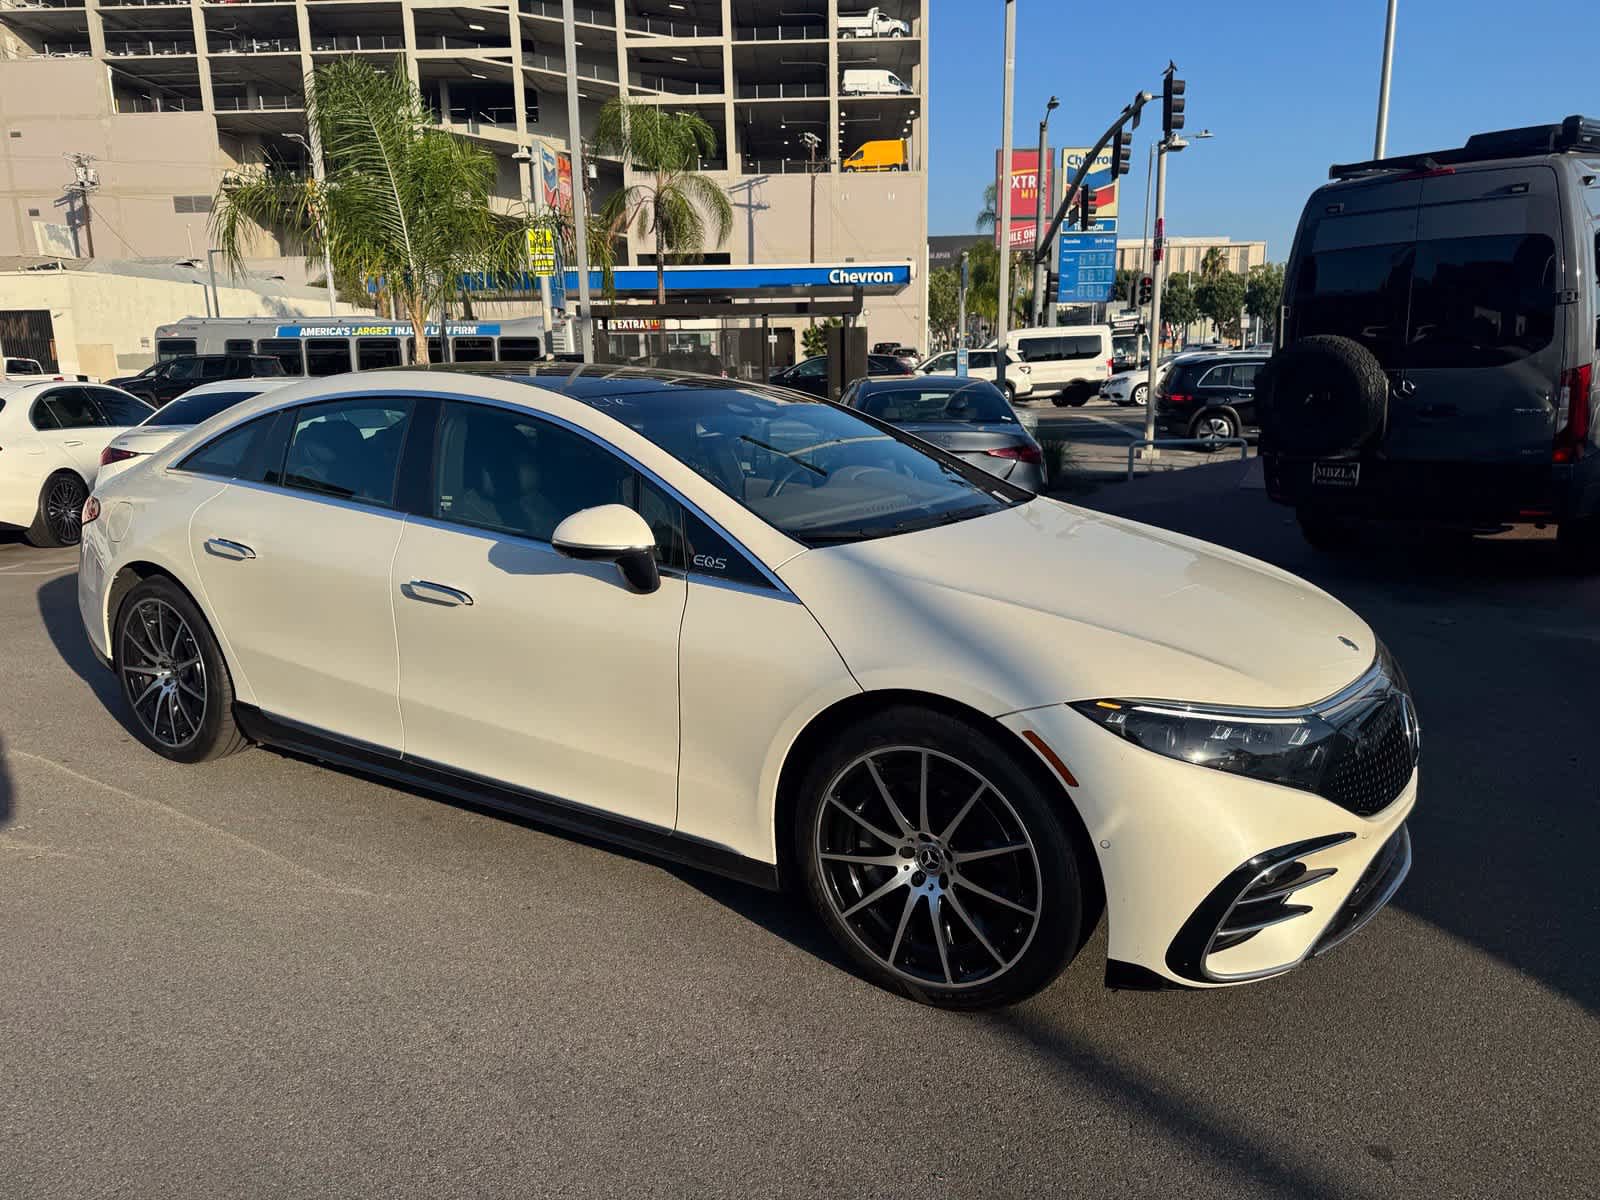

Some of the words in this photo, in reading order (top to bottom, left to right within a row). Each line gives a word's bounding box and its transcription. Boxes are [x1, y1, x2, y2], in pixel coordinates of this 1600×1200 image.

[1067, 153, 1112, 165] Chro
[1011, 175, 1036, 189] XTR
[829, 269, 893, 284] Chevron
[299, 326, 351, 336] AMERICA'S
[352, 325, 393, 336] LARGEST
[394, 326, 429, 336] INJUY
[453, 326, 477, 335] FIRM
[617, 319, 645, 329] EXTRA
[693, 554, 727, 569] EQS
